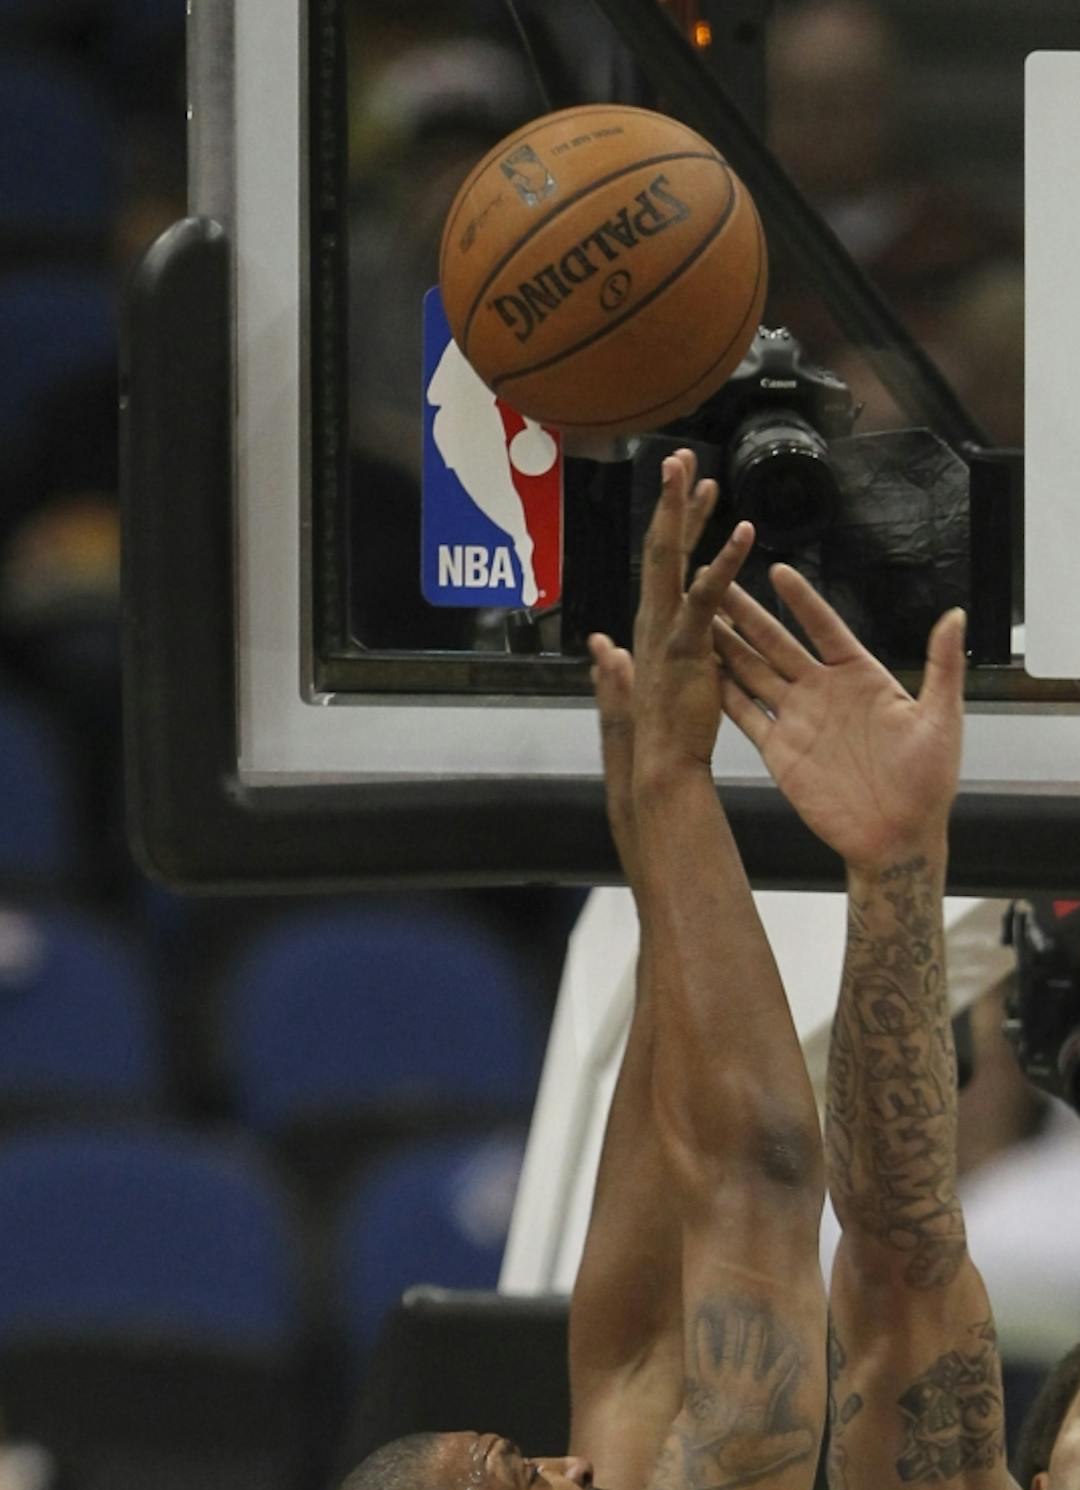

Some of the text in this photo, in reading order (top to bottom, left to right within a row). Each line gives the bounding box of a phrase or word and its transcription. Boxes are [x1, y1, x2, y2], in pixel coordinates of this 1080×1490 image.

[493, 174, 690, 344] SPALDING
[759, 377, 797, 390] Canon
[438, 544, 516, 589] NBA
